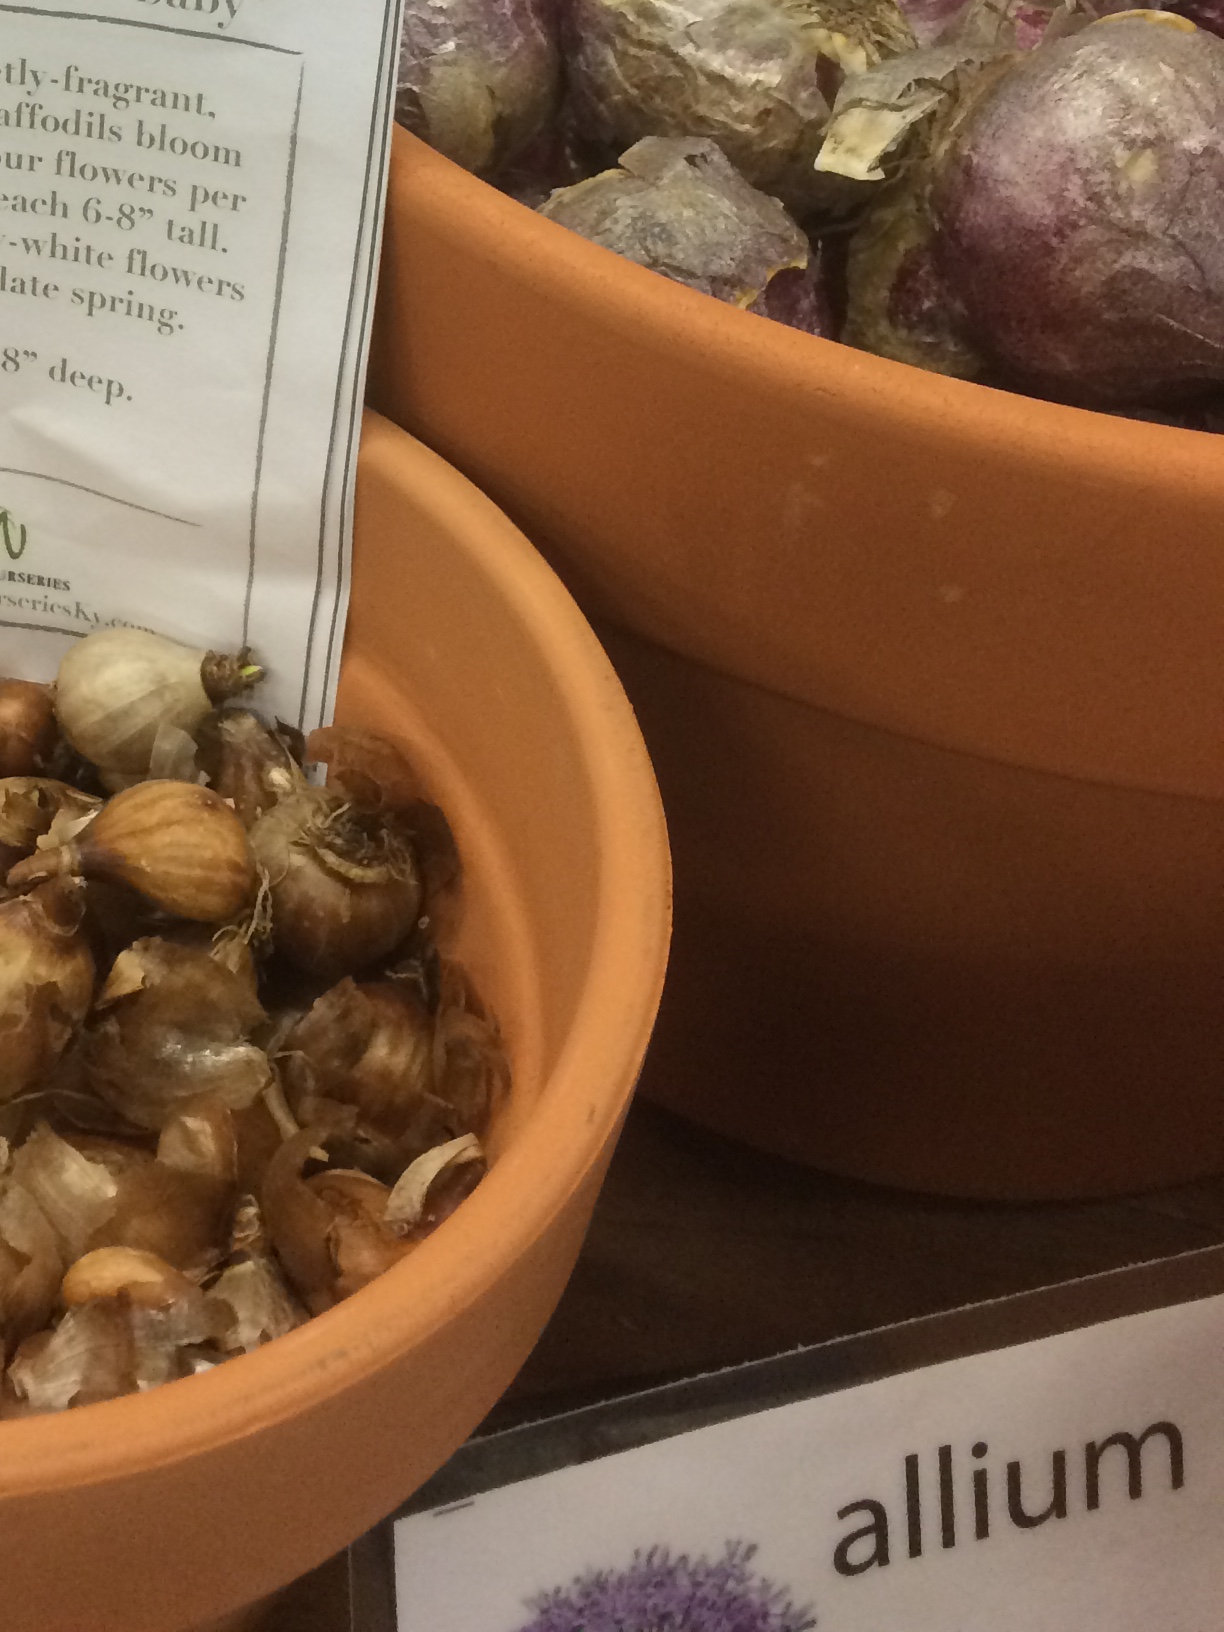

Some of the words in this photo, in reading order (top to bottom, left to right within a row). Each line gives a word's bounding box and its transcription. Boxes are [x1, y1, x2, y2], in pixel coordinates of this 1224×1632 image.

[135, 119, 243, 168] bloom
[54, 149, 177, 198] flowers
[190, 181, 247, 212] per
[82, 196, 153, 230] 6-8”
[166, 218, 228, 254] tall.
[0, 266, 60, 300] late
[71, 287, 184, 334] spring.
[125, 248, 246, 302] flowers
[48, 362, 133, 402] deep.
[831, 1419, 1186, 1577] allium
